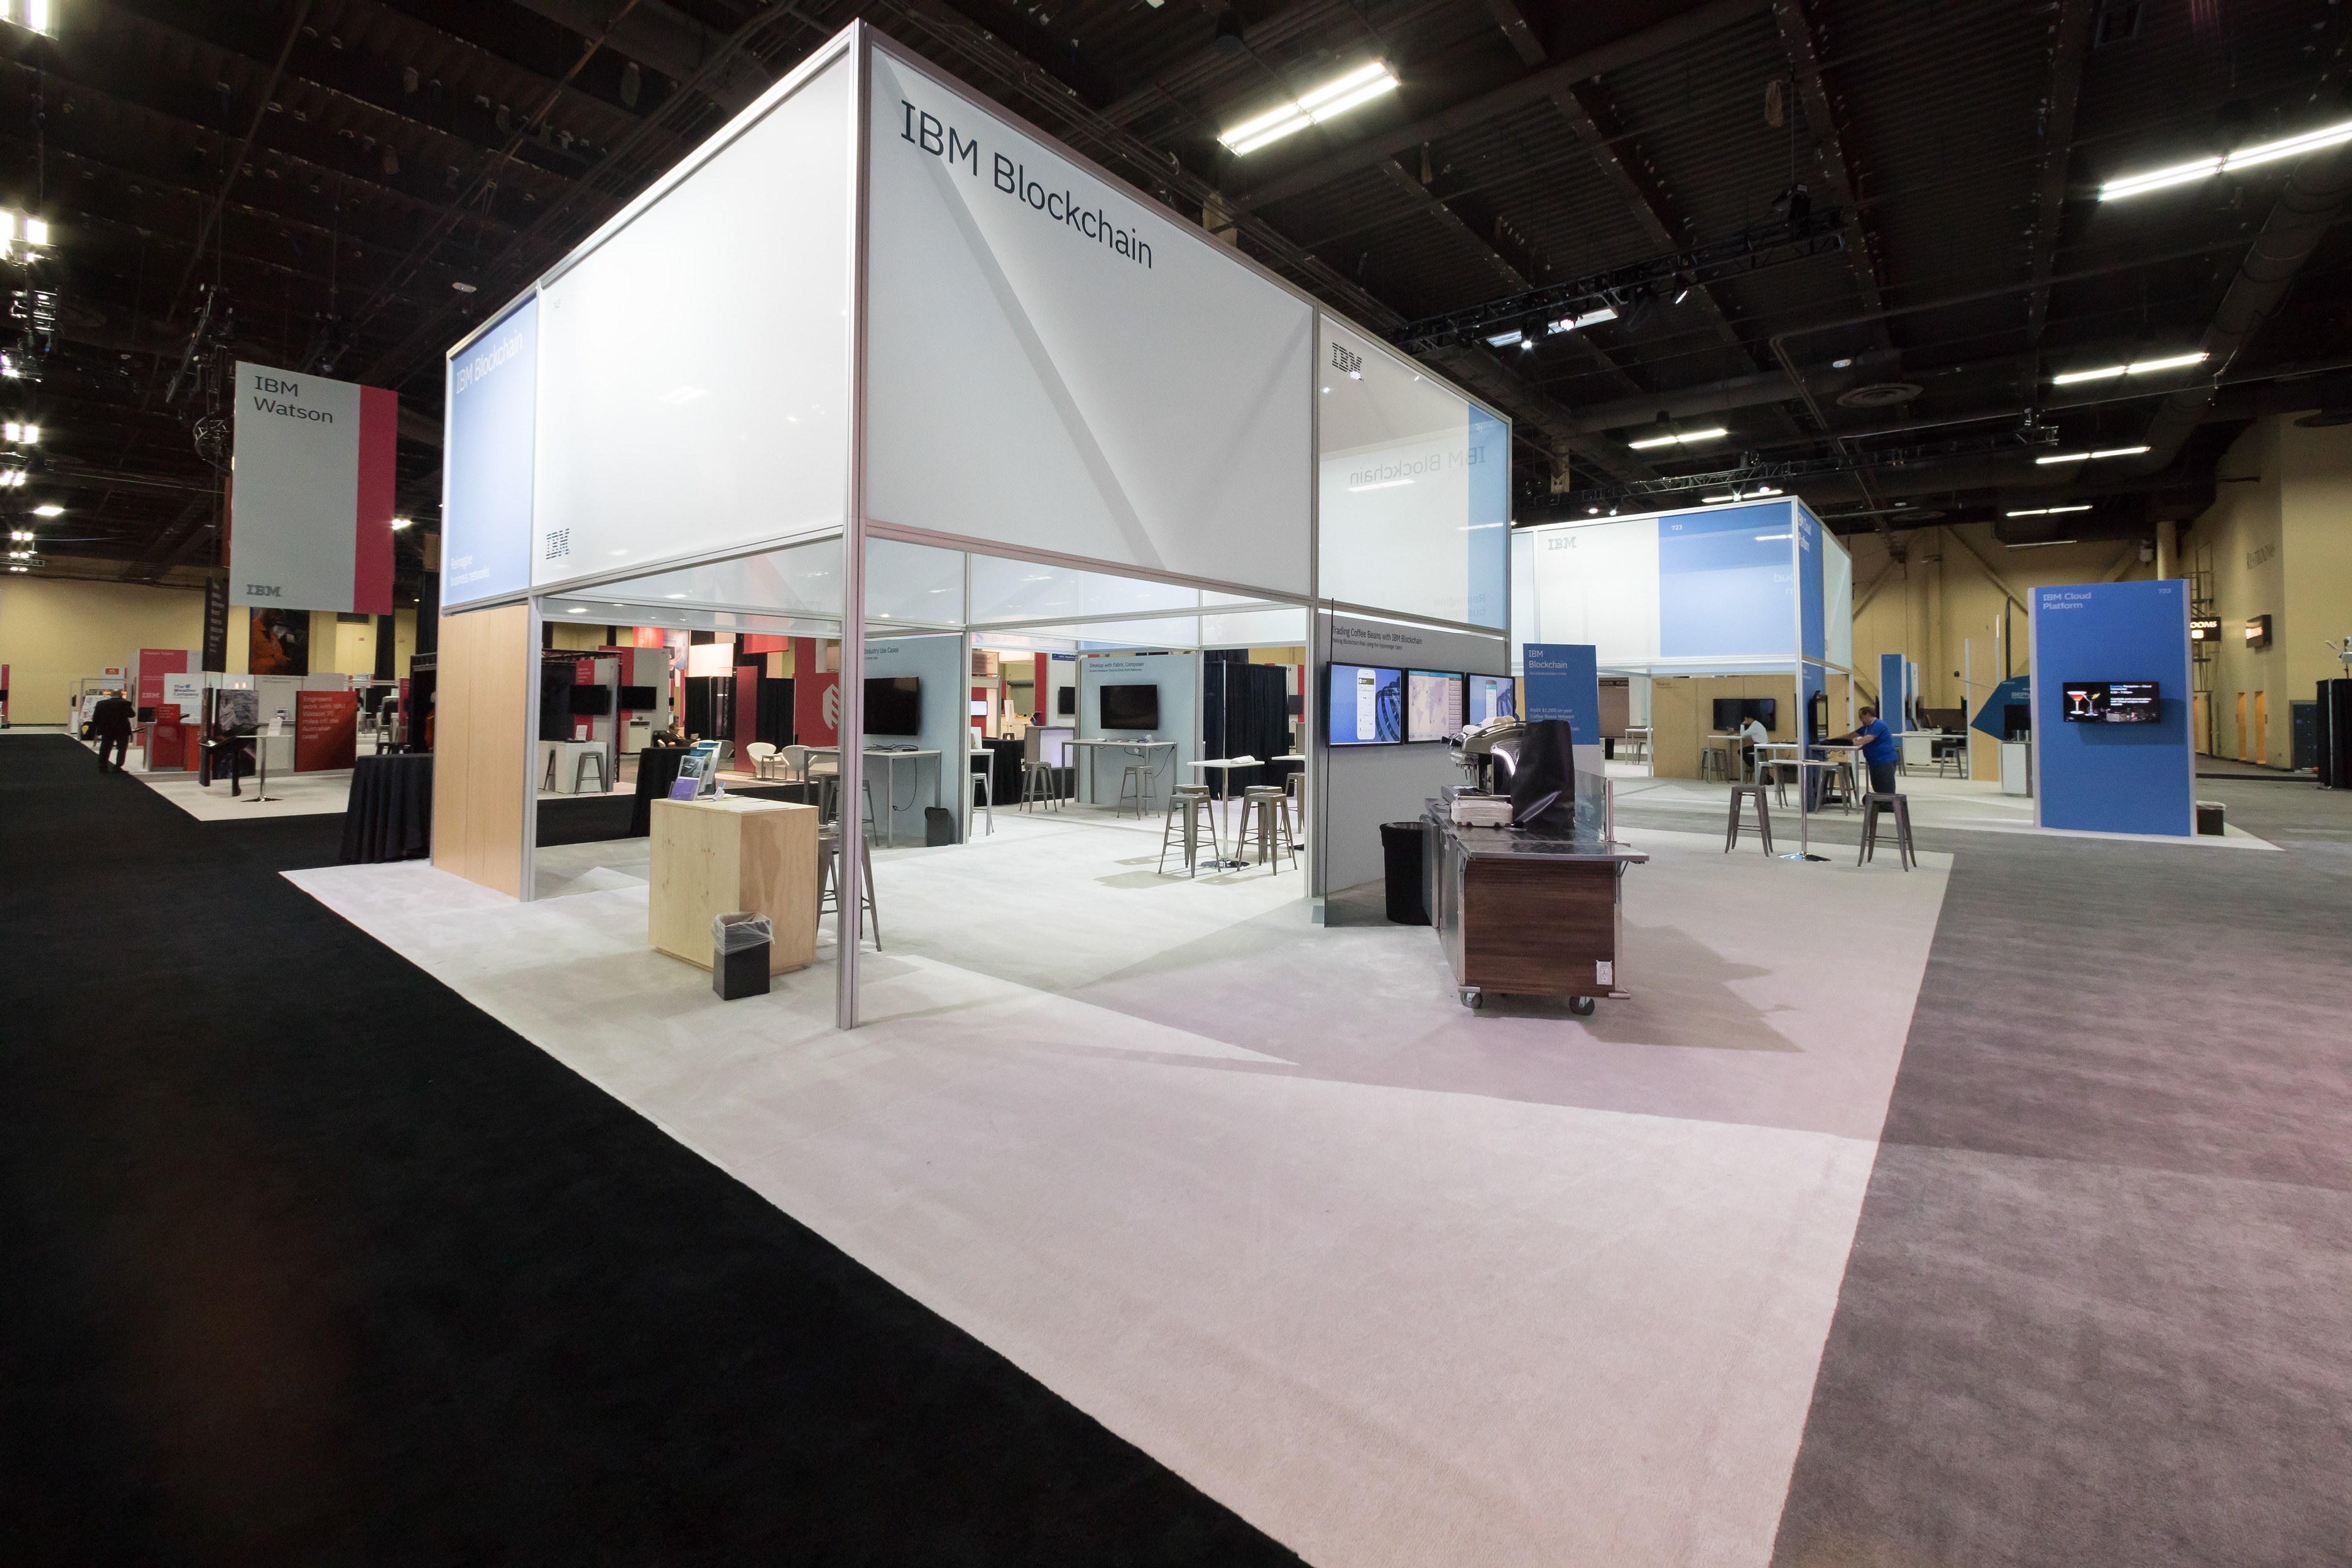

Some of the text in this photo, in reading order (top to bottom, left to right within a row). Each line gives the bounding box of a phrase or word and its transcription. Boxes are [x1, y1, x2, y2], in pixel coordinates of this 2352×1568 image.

[900, 99, 1153, 269] IBM Blockchain
[456, 329, 522, 394] IBM Blockchain
[1332, 342, 1362, 380] IBM
[254, 375, 299, 398] IBM
[254, 396, 333, 424] Watson
[546, 528, 570, 559] IBM
[1548, 537, 1576, 551] IBM
[247, 584, 282, 597] IBM
[1332, 626, 1350, 638] Trading
[1351, 628, 1366, 638] Coffee
[1367, 630, 1381, 639] Beans
[1401, 635, 1422, 644] Blockchain
